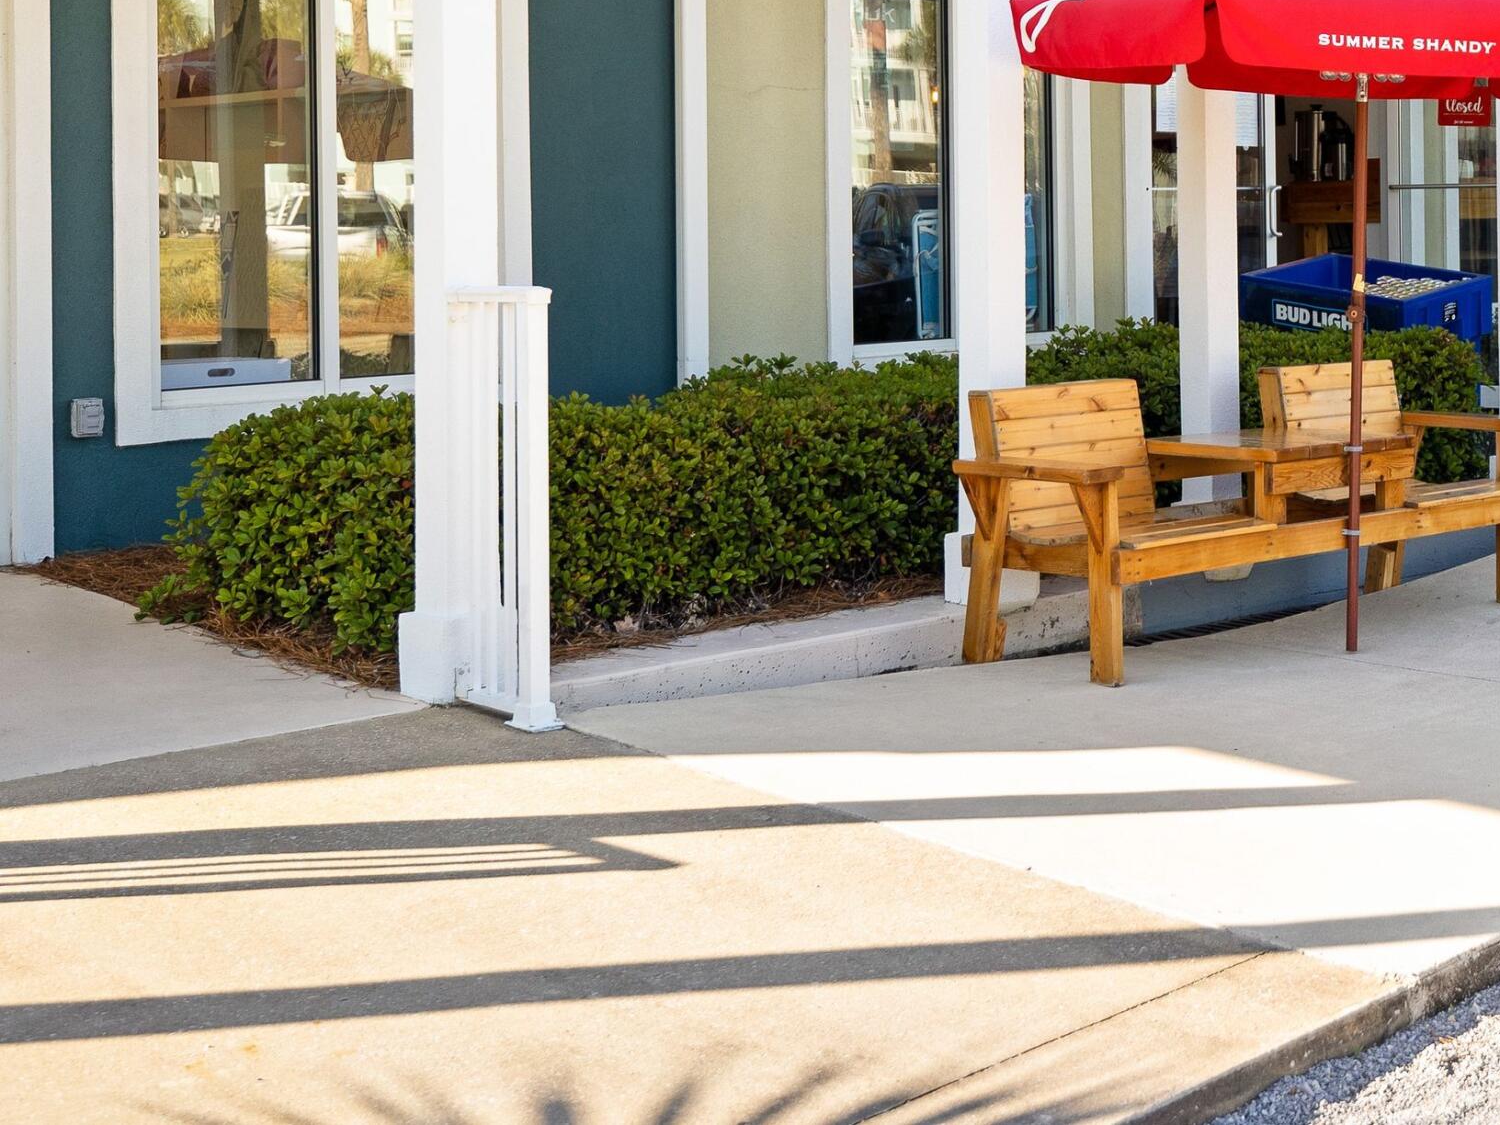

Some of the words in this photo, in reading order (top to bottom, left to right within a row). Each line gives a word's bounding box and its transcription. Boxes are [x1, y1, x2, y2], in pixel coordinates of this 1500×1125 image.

[1318, 33, 1405, 50] SUMMER
[1412, 37, 1495, 54] SHANDY
[1446, 96, 1483, 113] Closed
[1275, 303, 1311, 325] BUD
[1312, 310, 1353, 331] LIGH
